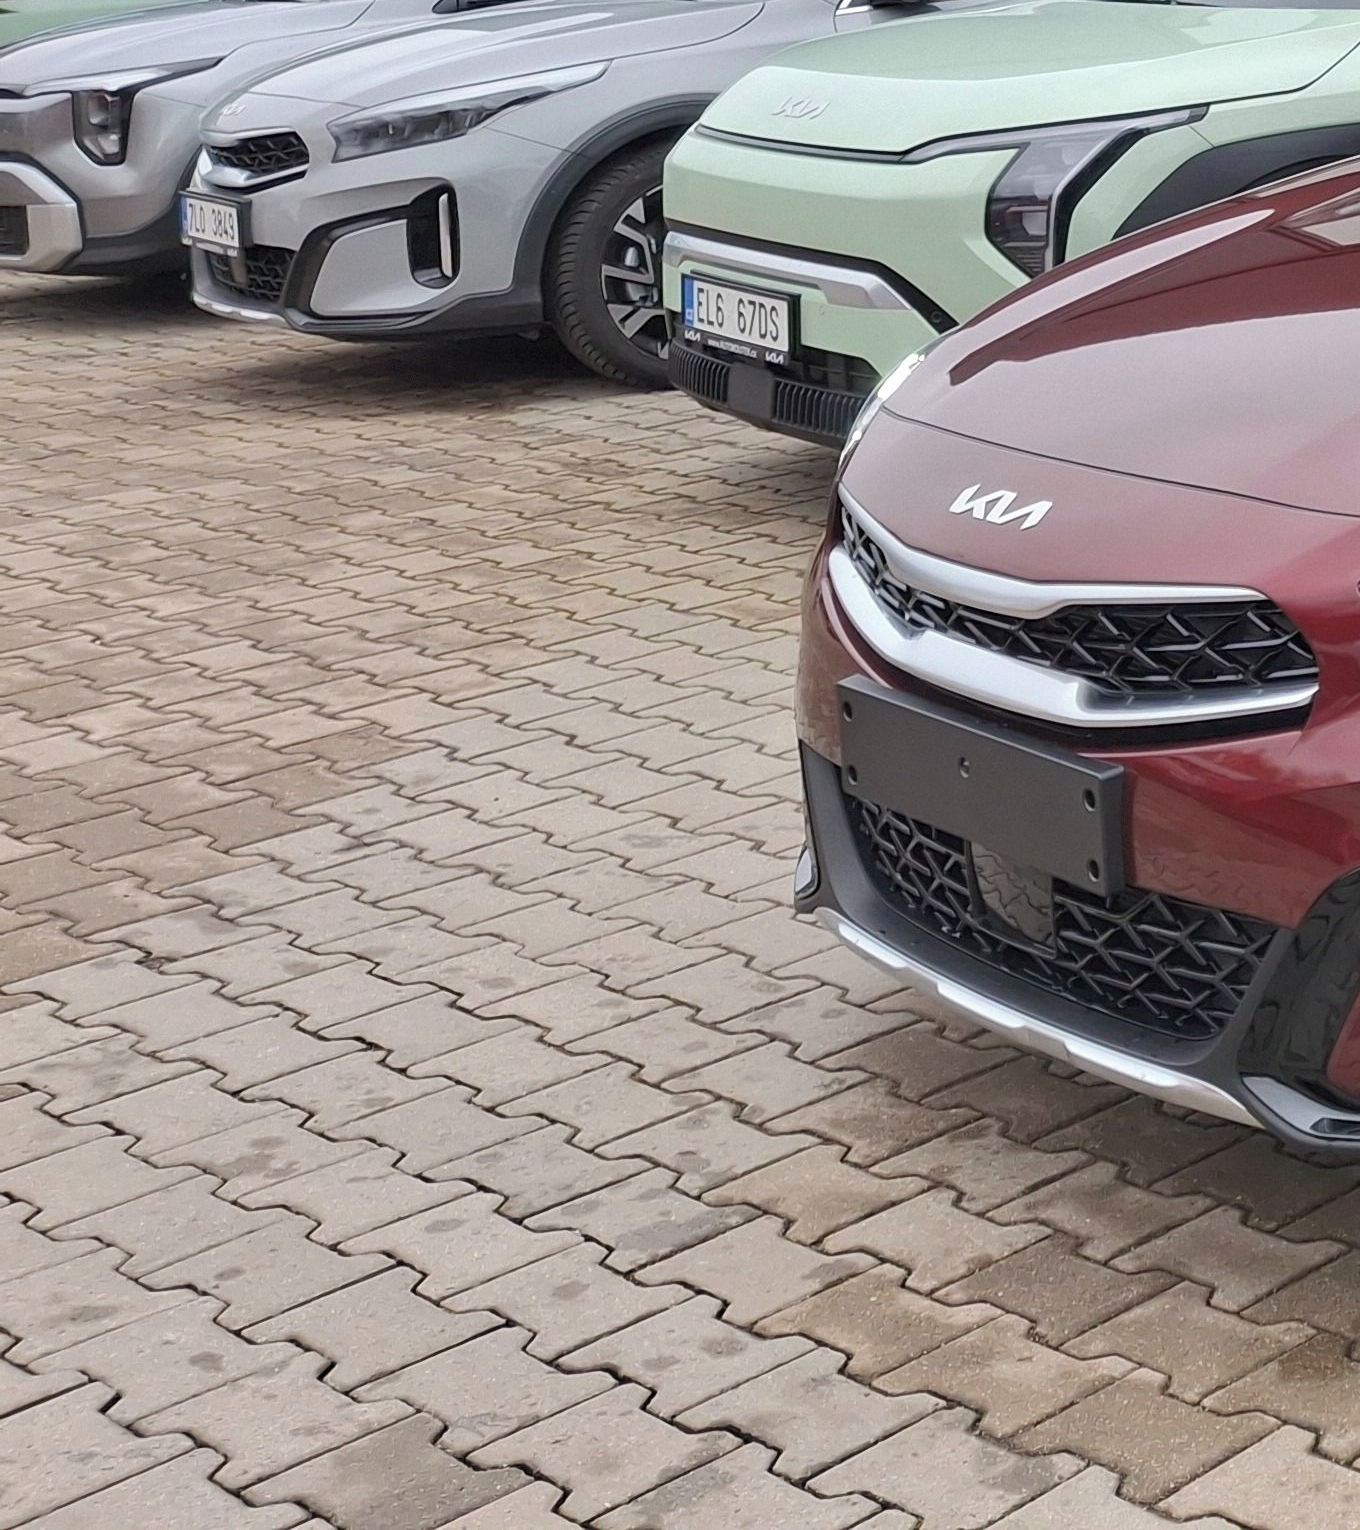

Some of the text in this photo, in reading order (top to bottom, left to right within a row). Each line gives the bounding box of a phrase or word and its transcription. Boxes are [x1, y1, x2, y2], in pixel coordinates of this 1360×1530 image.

[771, 95, 831, 121] KIA
[211, 209, 235, 241] 3849
[696, 287, 779, 343] EL6 67DS
[684, 329, 701, 343] KIA
[765, 350, 784, 365] KIA
[948, 482, 1053, 532] KIA
